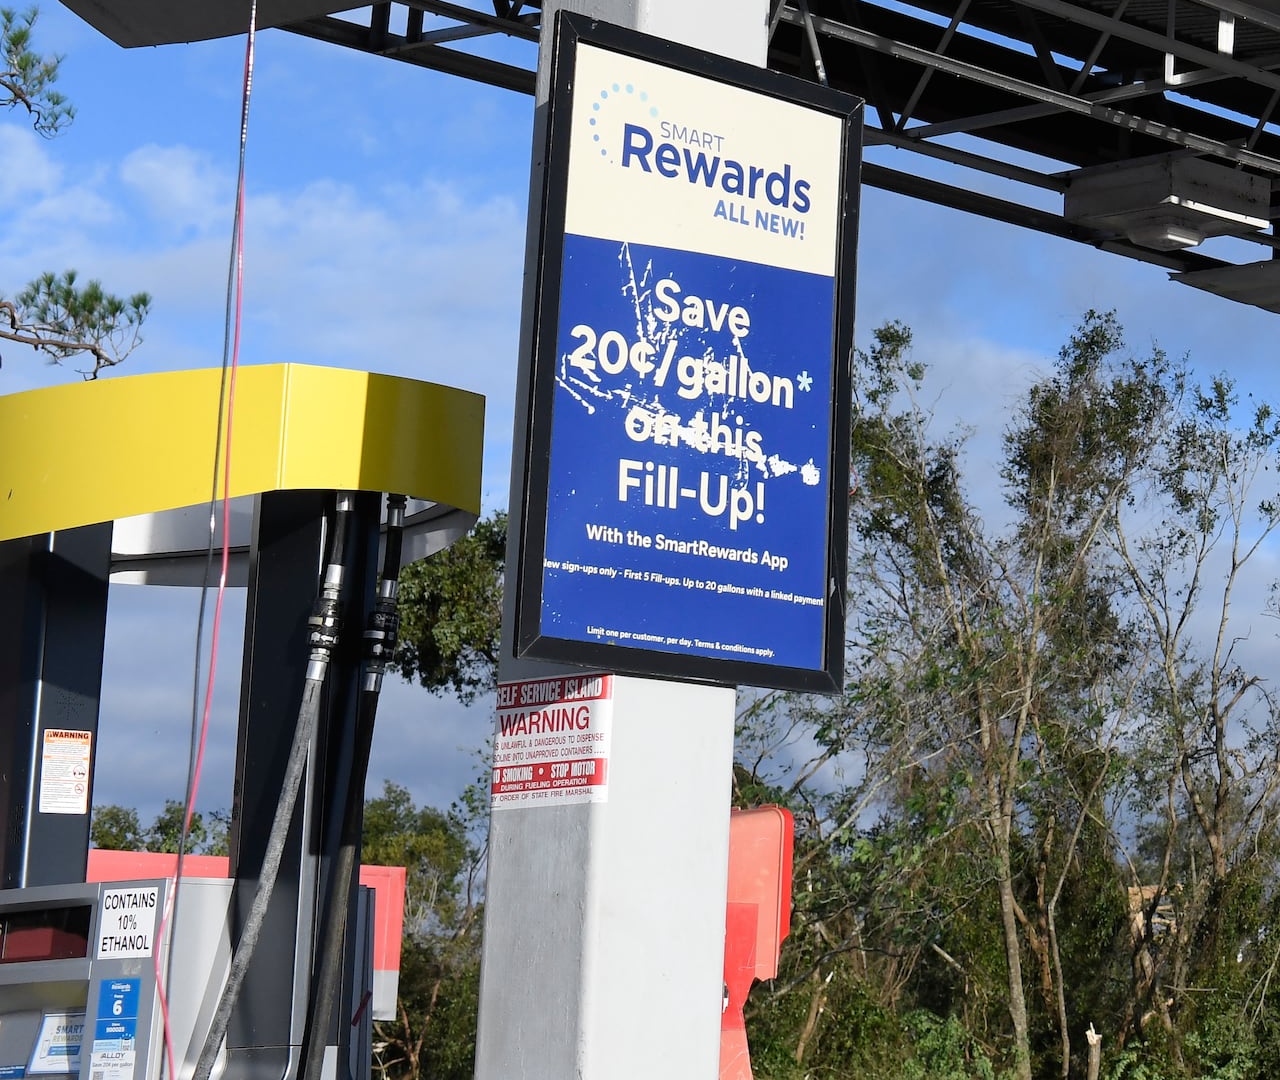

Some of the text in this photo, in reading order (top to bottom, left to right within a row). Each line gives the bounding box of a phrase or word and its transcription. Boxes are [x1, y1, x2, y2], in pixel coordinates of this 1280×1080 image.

[660, 121, 725, 153] SMART
[621, 123, 811, 213] Rewards
[713, 199, 805, 241] ALL NEW!
[653, 279, 750, 338] Save
[624, 406, 764, 463] on this
[617, 458, 766, 530] Fill-Up!
[586, 523, 789, 572] With the SmartRewards App
[561, 560, 598, 575] sign-ups
[598, 566, 618, 578] only
[623, 569, 642, 582] First
[643, 571, 650, 582] 5
[650, 572, 681, 587] Fill-ups.
[682, 577, 694, 590] Up
[695, 579, 705, 590] to
[705, 580, 717, 591] 20
[717, 582, 745, 596] gallons
[746, 586, 764, 598] with
[764, 591, 770, 599] a
[770, 589, 793, 603] linked
[793, 594, 824, 607] payment
[587, 625, 775, 658] Limit one per customer, per day. Terms & conditions apply.
[496, 677, 602, 707] SELF SERVICE ISLAND
[500, 705, 590, 737] WARNING
[52, 731, 89, 739] WARNING
[501, 740, 527, 751] UNLAWFUL
[529, 740, 533, 748] &
[534, 735, 566, 747] DANGEROUS
[568, 735, 575, 744] TO
[576, 732, 604, 743] DISPENSE
[512, 753, 524, 762] INTO
[525, 750, 558, 761] UNAPPROVED
[560, 745, 593, 757] CONTAINERS
[500, 777, 587, 791] DURING FUELING OPERATION
[502, 765, 533, 783] SMOKING
[551, 763, 569, 779] STOP
[570, 760, 595, 777] MOTOR
[500, 793, 519, 802] ORDER
[521, 792, 528, 800] OF
[531, 791, 548, 800] STATE
[550, 789, 563, 797] FIRE
[565, 787, 593, 797] MARSHAL
[104, 892, 156, 910] CONTAINS
[118, 914, 137, 930] 10%
[101, 934, 150, 952] ETHANOL
[112, 999, 122, 1016] 6
[56, 1024, 84, 1035] SMART
